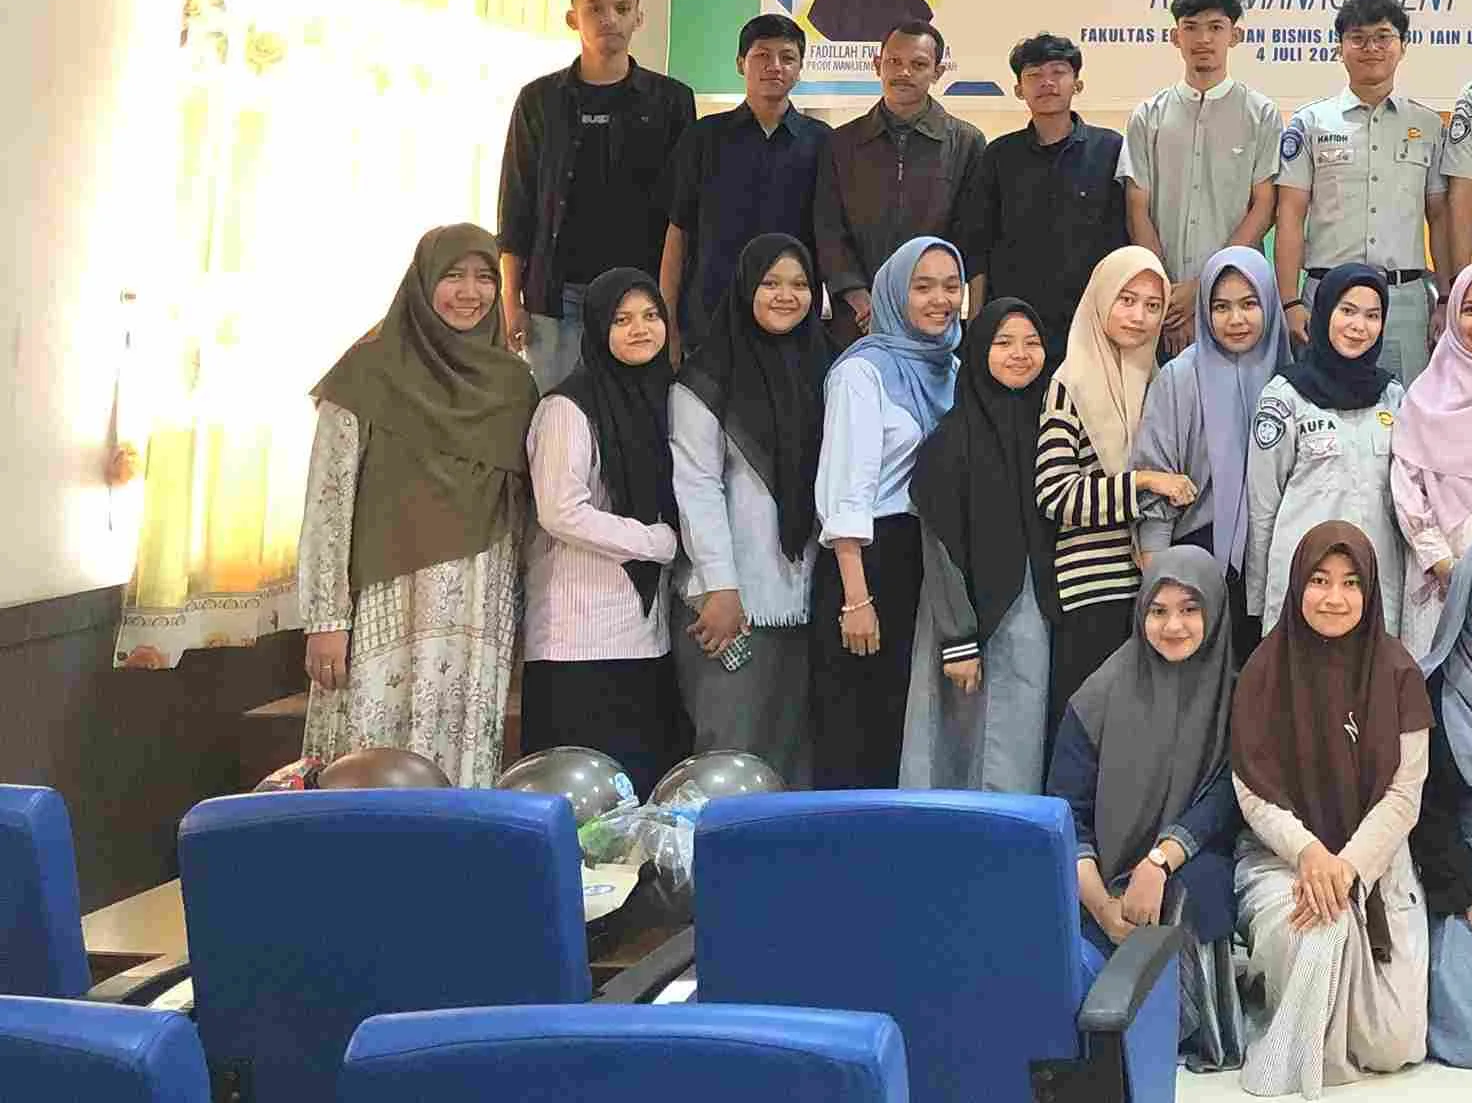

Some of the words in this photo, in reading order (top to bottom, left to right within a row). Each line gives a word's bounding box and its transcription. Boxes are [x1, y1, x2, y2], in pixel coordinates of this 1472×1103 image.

[1080, 28, 1154, 43] FAKULTAS
[1272, 29, 1321, 43] BISNIS
[1430, 30, 1460, 45] IAIN
[810, 45, 858, 58] FADILLAH
[1256, 47, 1265, 61] 4
[1272, 47, 1301, 62] JULI
[1309, 47, 1338, 62] 202
[1299, 419, 1337, 434] AUFA
